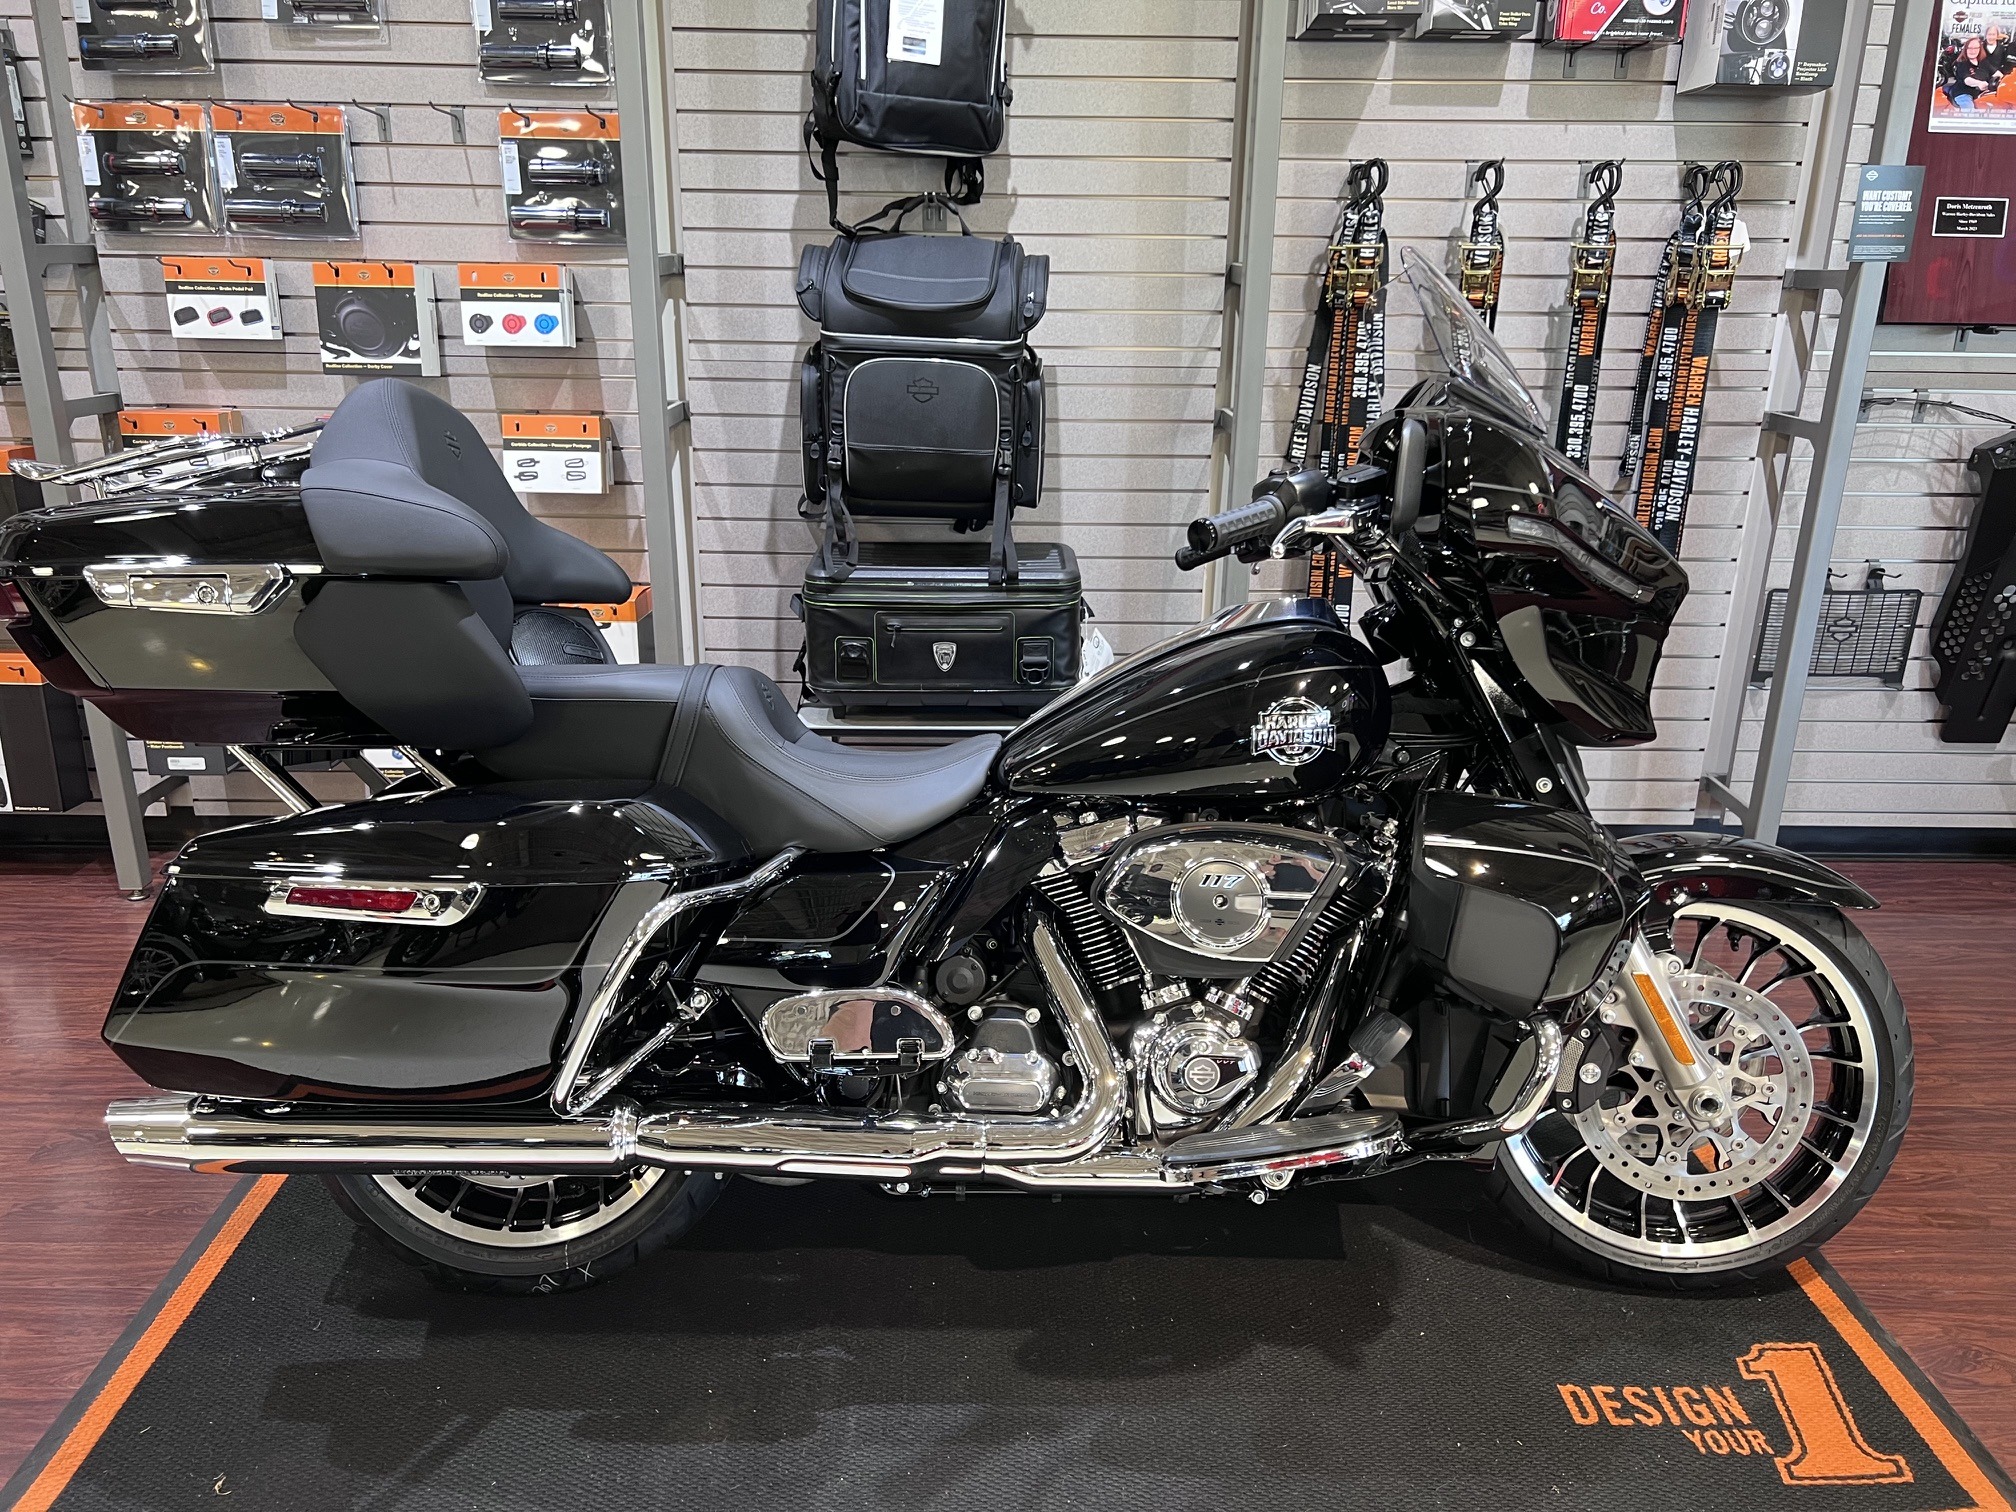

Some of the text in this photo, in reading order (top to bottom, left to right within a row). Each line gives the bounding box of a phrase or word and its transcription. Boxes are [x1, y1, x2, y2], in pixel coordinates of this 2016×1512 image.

[1590, 1, 1606, 15] Co.
[1952, 24, 1982, 34] FEMALES
[1861, 201, 1913, 212] YOU'RE COVERED.
[1862, 190, 1913, 201] WANT CUSTOM?
[1644, 308, 1663, 357] WARREN
[1654, 327, 1679, 401] 330.395.4700
[1291, 364, 1322, 464] ARLEY-DAVIDSON
[1566, 384, 1589, 458] 330.395.4700
[1665, 356, 1709, 522] WARREN HARLEY-DAVIDSON
[1635, 428, 1664, 528] ARLEYDAVIDSON.COM
[1256, 728, 1334, 751] DAVIDSON
[1264, 714, 1328, 730] HARLEY
[1199, 873, 1246, 889] 117
[1556, 1383, 1751, 1427] DESIGN
[1736, 1341, 1914, 1484] 1
[1681, 1427, 1774, 1455] YOUR
